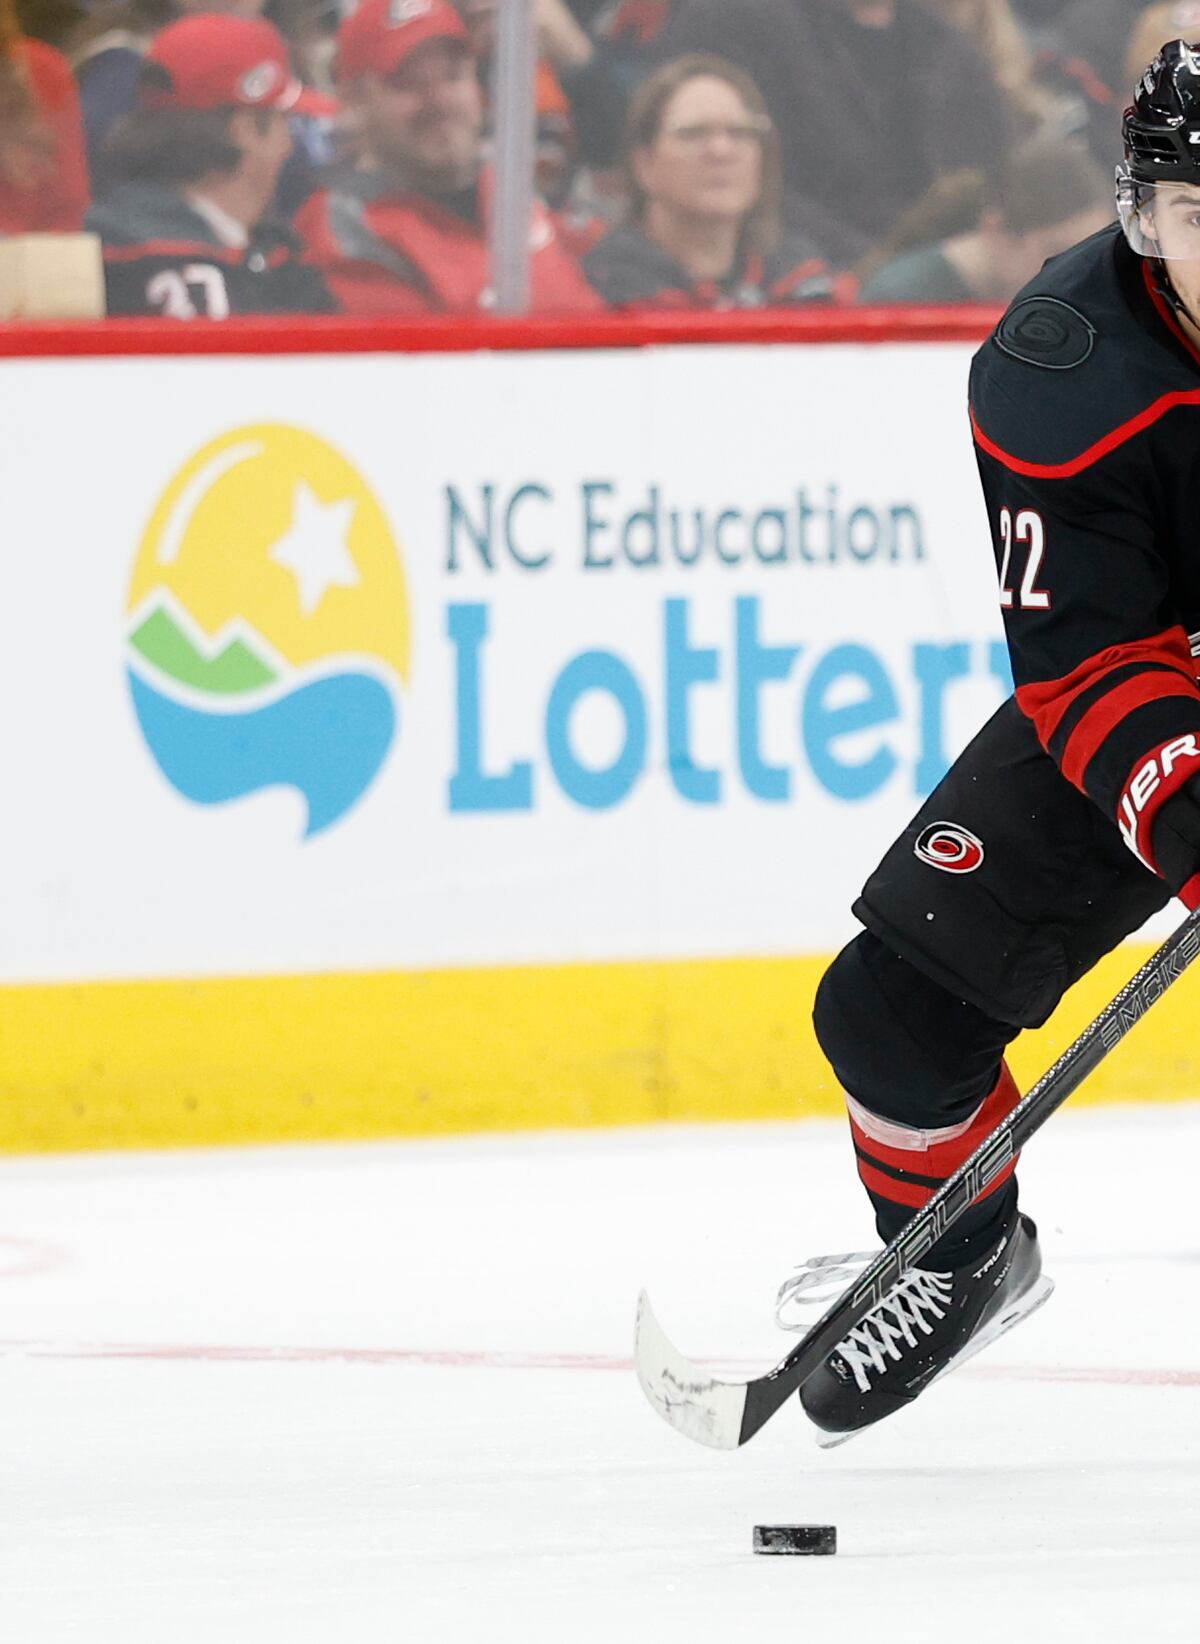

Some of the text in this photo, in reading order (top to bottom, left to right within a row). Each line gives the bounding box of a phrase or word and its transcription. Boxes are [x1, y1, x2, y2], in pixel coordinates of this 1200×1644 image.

[444, 481, 928, 572] NC Education
[998, 505, 1053, 610] 22
[445, 595, 1015, 813] Lotter
[851, 1127, 1014, 1309] TRUE
